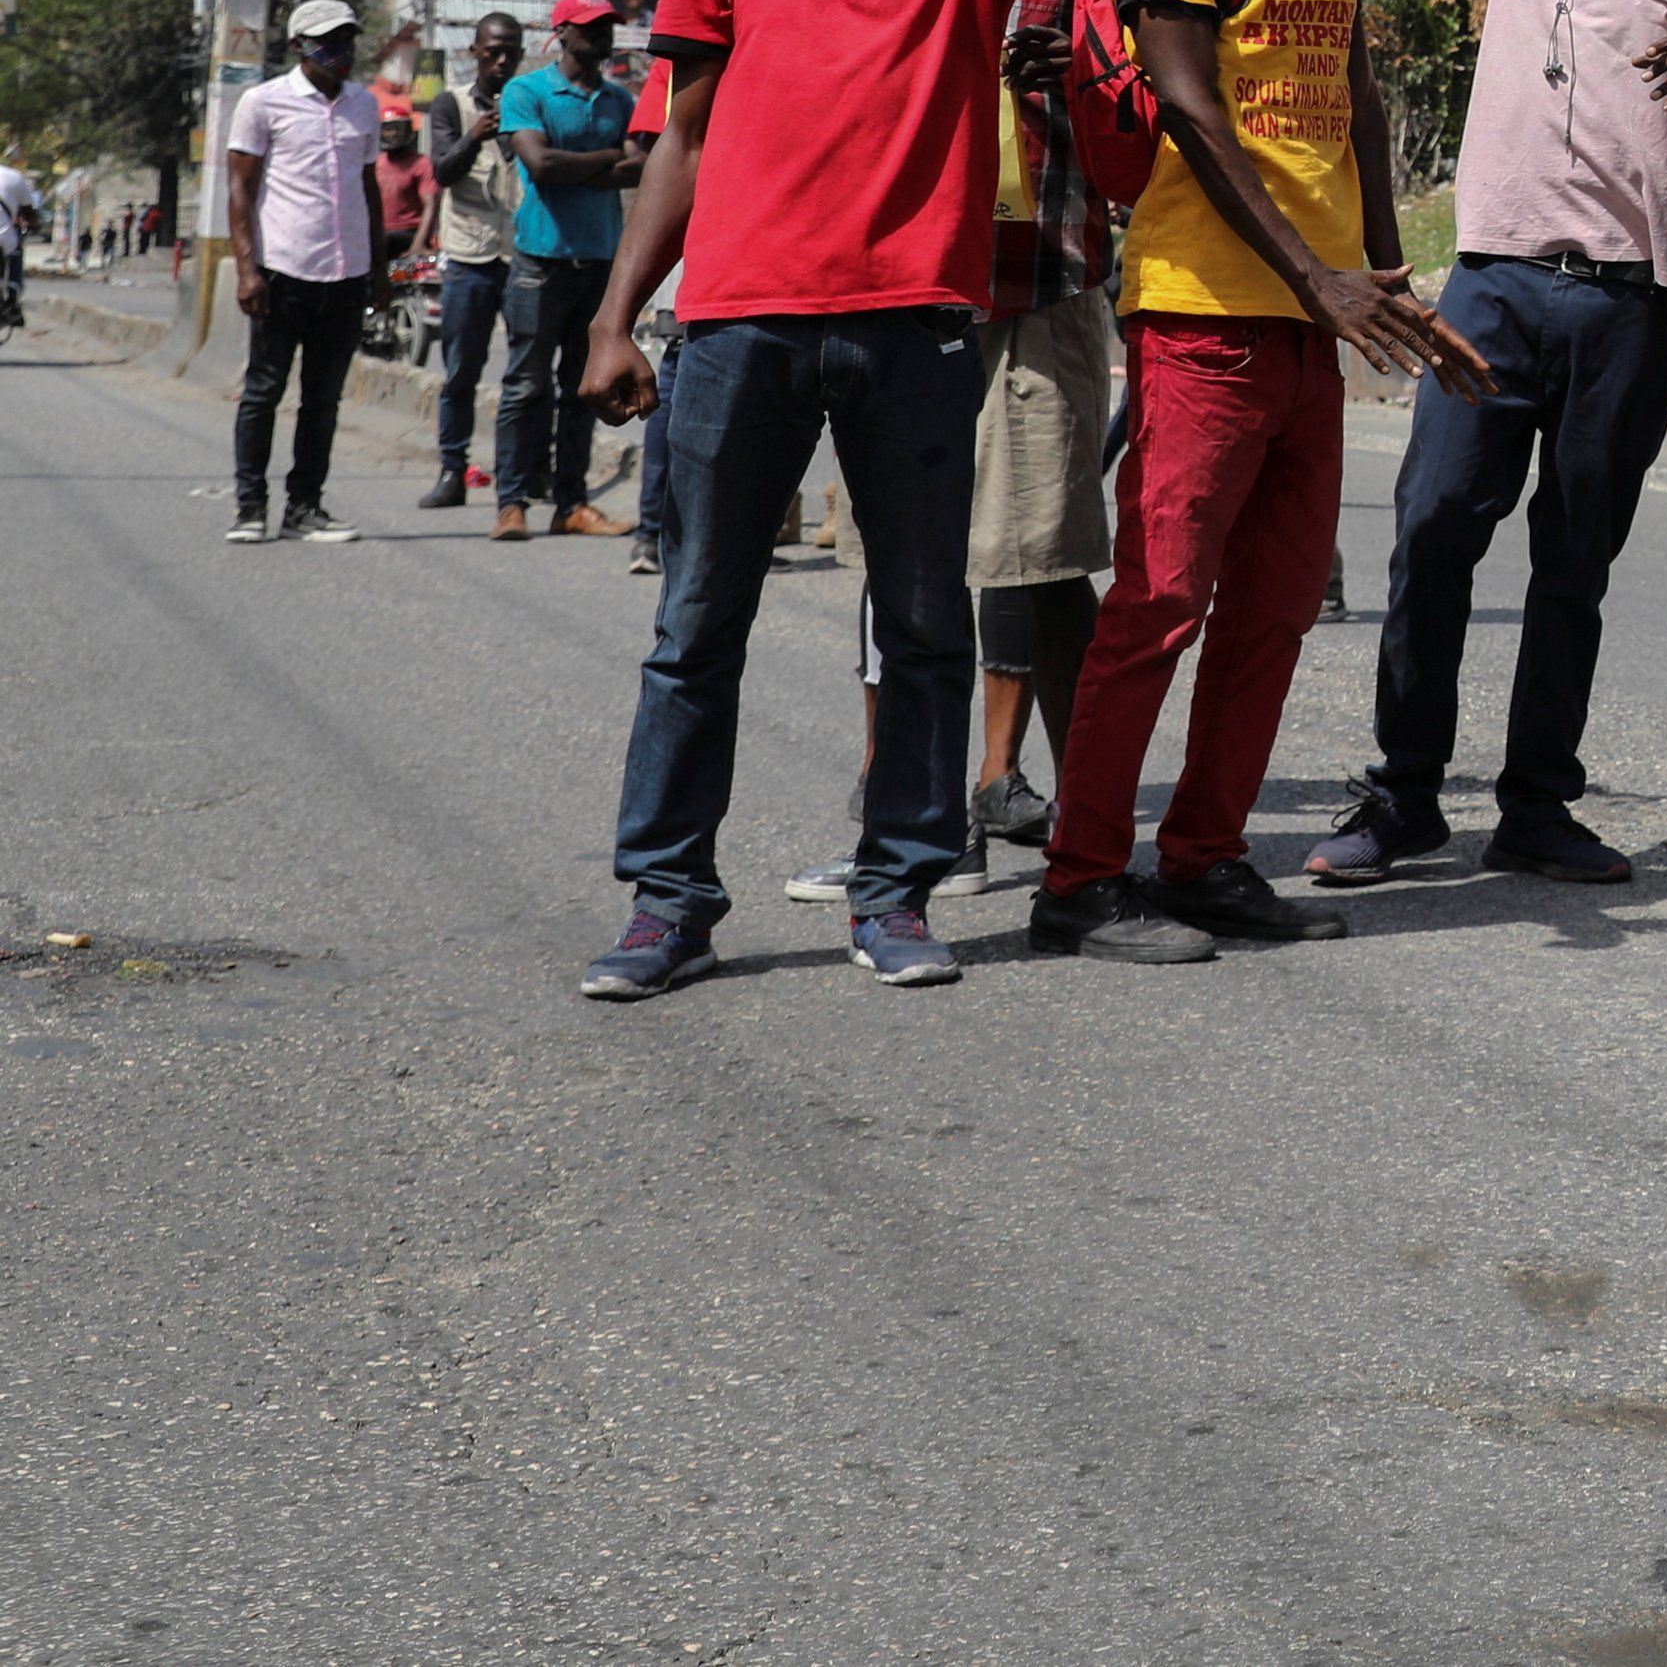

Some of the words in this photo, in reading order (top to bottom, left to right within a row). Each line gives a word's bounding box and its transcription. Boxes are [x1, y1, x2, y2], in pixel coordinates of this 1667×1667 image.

[1262, 0, 1355, 25] MONTAN
[1240, 21, 1290, 47] AK
[1293, 23, 1352, 50] KPSA
[1243, 111, 1280, 139] NAN
[1330, 115, 1352, 143] PEY
